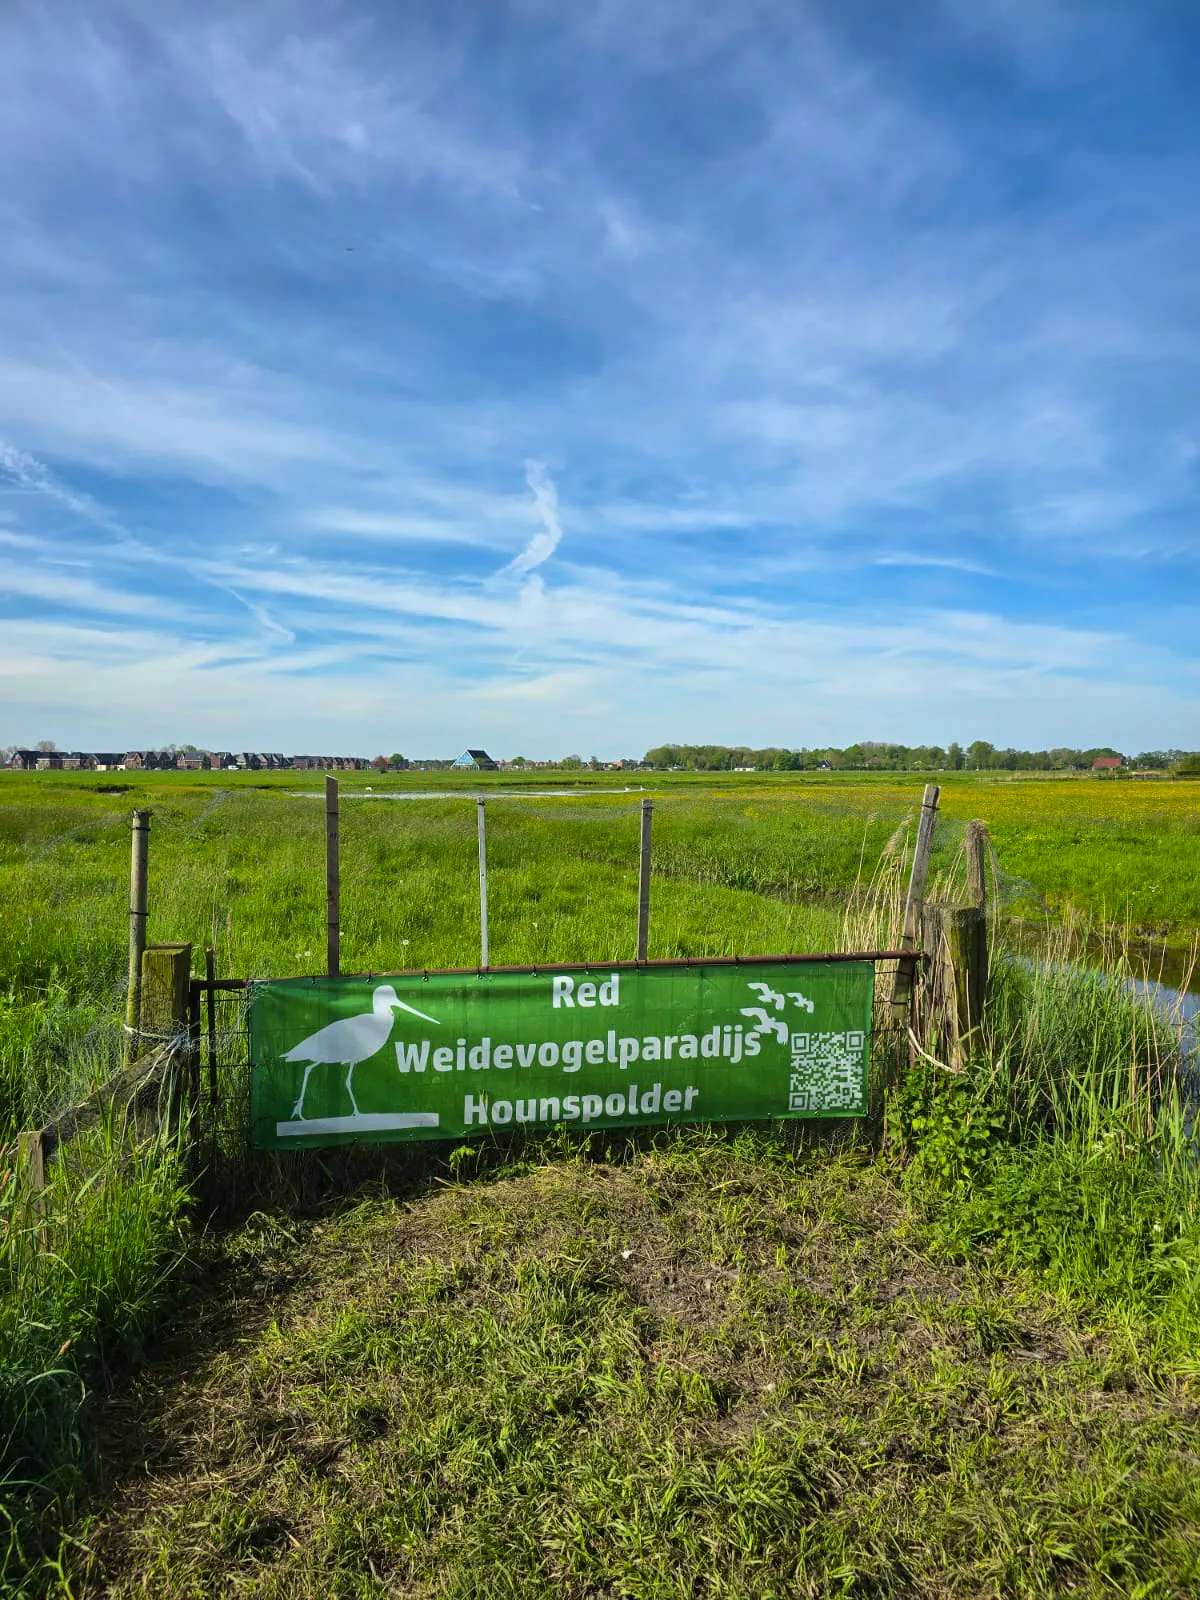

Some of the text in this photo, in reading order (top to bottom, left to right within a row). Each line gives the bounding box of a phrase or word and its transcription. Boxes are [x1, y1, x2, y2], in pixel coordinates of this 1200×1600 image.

[552, 973, 620, 1008] Red
[394, 1025, 761, 1073] Weidevogelparadijs
[464, 1082, 699, 1125] Hounspolder
